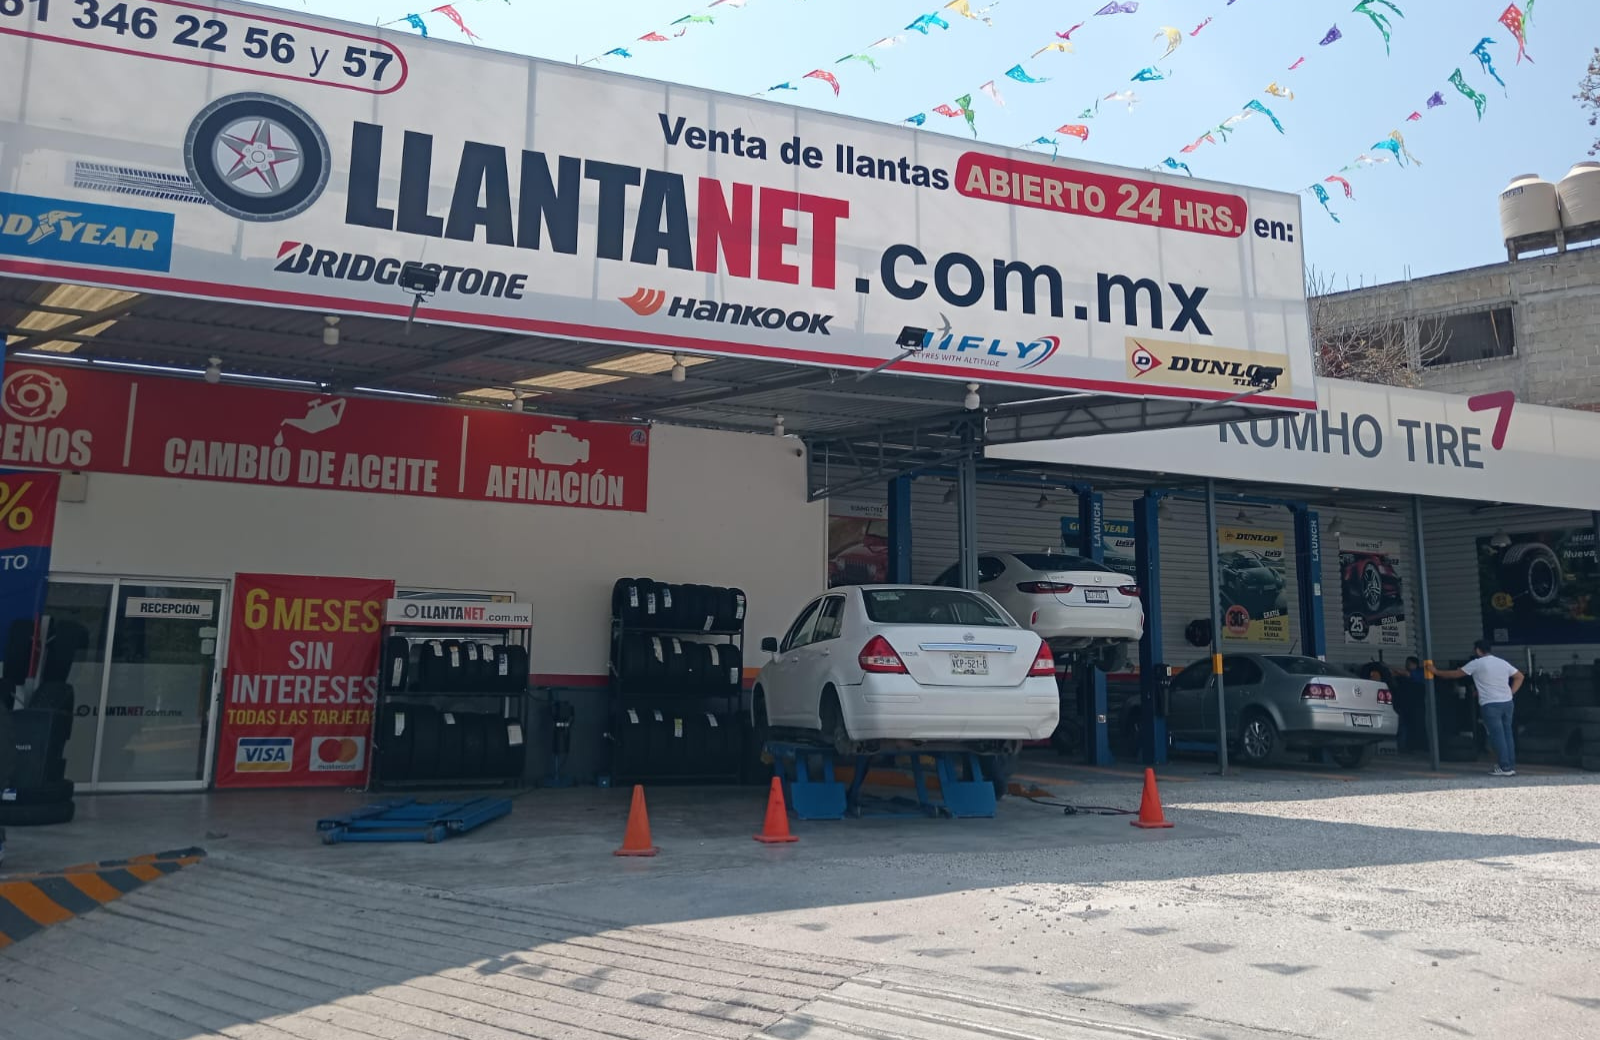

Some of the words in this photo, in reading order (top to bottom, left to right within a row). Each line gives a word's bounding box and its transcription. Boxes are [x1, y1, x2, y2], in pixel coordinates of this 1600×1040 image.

[72, 0, 158, 39] 346
[173, 15, 228, 53] 22
[243, 27, 296, 63] 56
[309, 47, 330, 77] y
[342, 46, 394, 81] 57
[658, 113, 767, 160] Venta
[780, 136, 824, 169] de
[836, 145, 949, 191] llantas
[964, 165, 1106, 214] ABIERTO
[1115, 183, 1163, 221] 24
[1173, 199, 1242, 234] HRS.
[1253, 217, 1295, 242] en:
[941, 354, 962, 363] WITH
[964, 356, 1001, 368] ALTITUDE
[0, 423, 93, 467] ENOS
[163, 437, 292, 482] CAMBIO
[298, 448, 335, 486] DE
[339, 452, 438, 493] ACEITE
[1396, 418, 1485, 469] TIRE
[485, 464, 624, 507] AFINACIÓN
[1235, 533, 1279, 542] DUNLOP
[1311, 519, 1320, 562] LAUNCH
[140, 602, 200, 615] RECEPCIÓN
[244, 588, 271, 630] 6
[272, 597, 381, 634] MESES
[288, 640, 335, 670] SIN
[231, 674, 379, 704] INTERESES
[227, 709, 277, 725] TODAS
[279, 709, 309, 725] LAS
[244, 747, 286, 762] VISA
